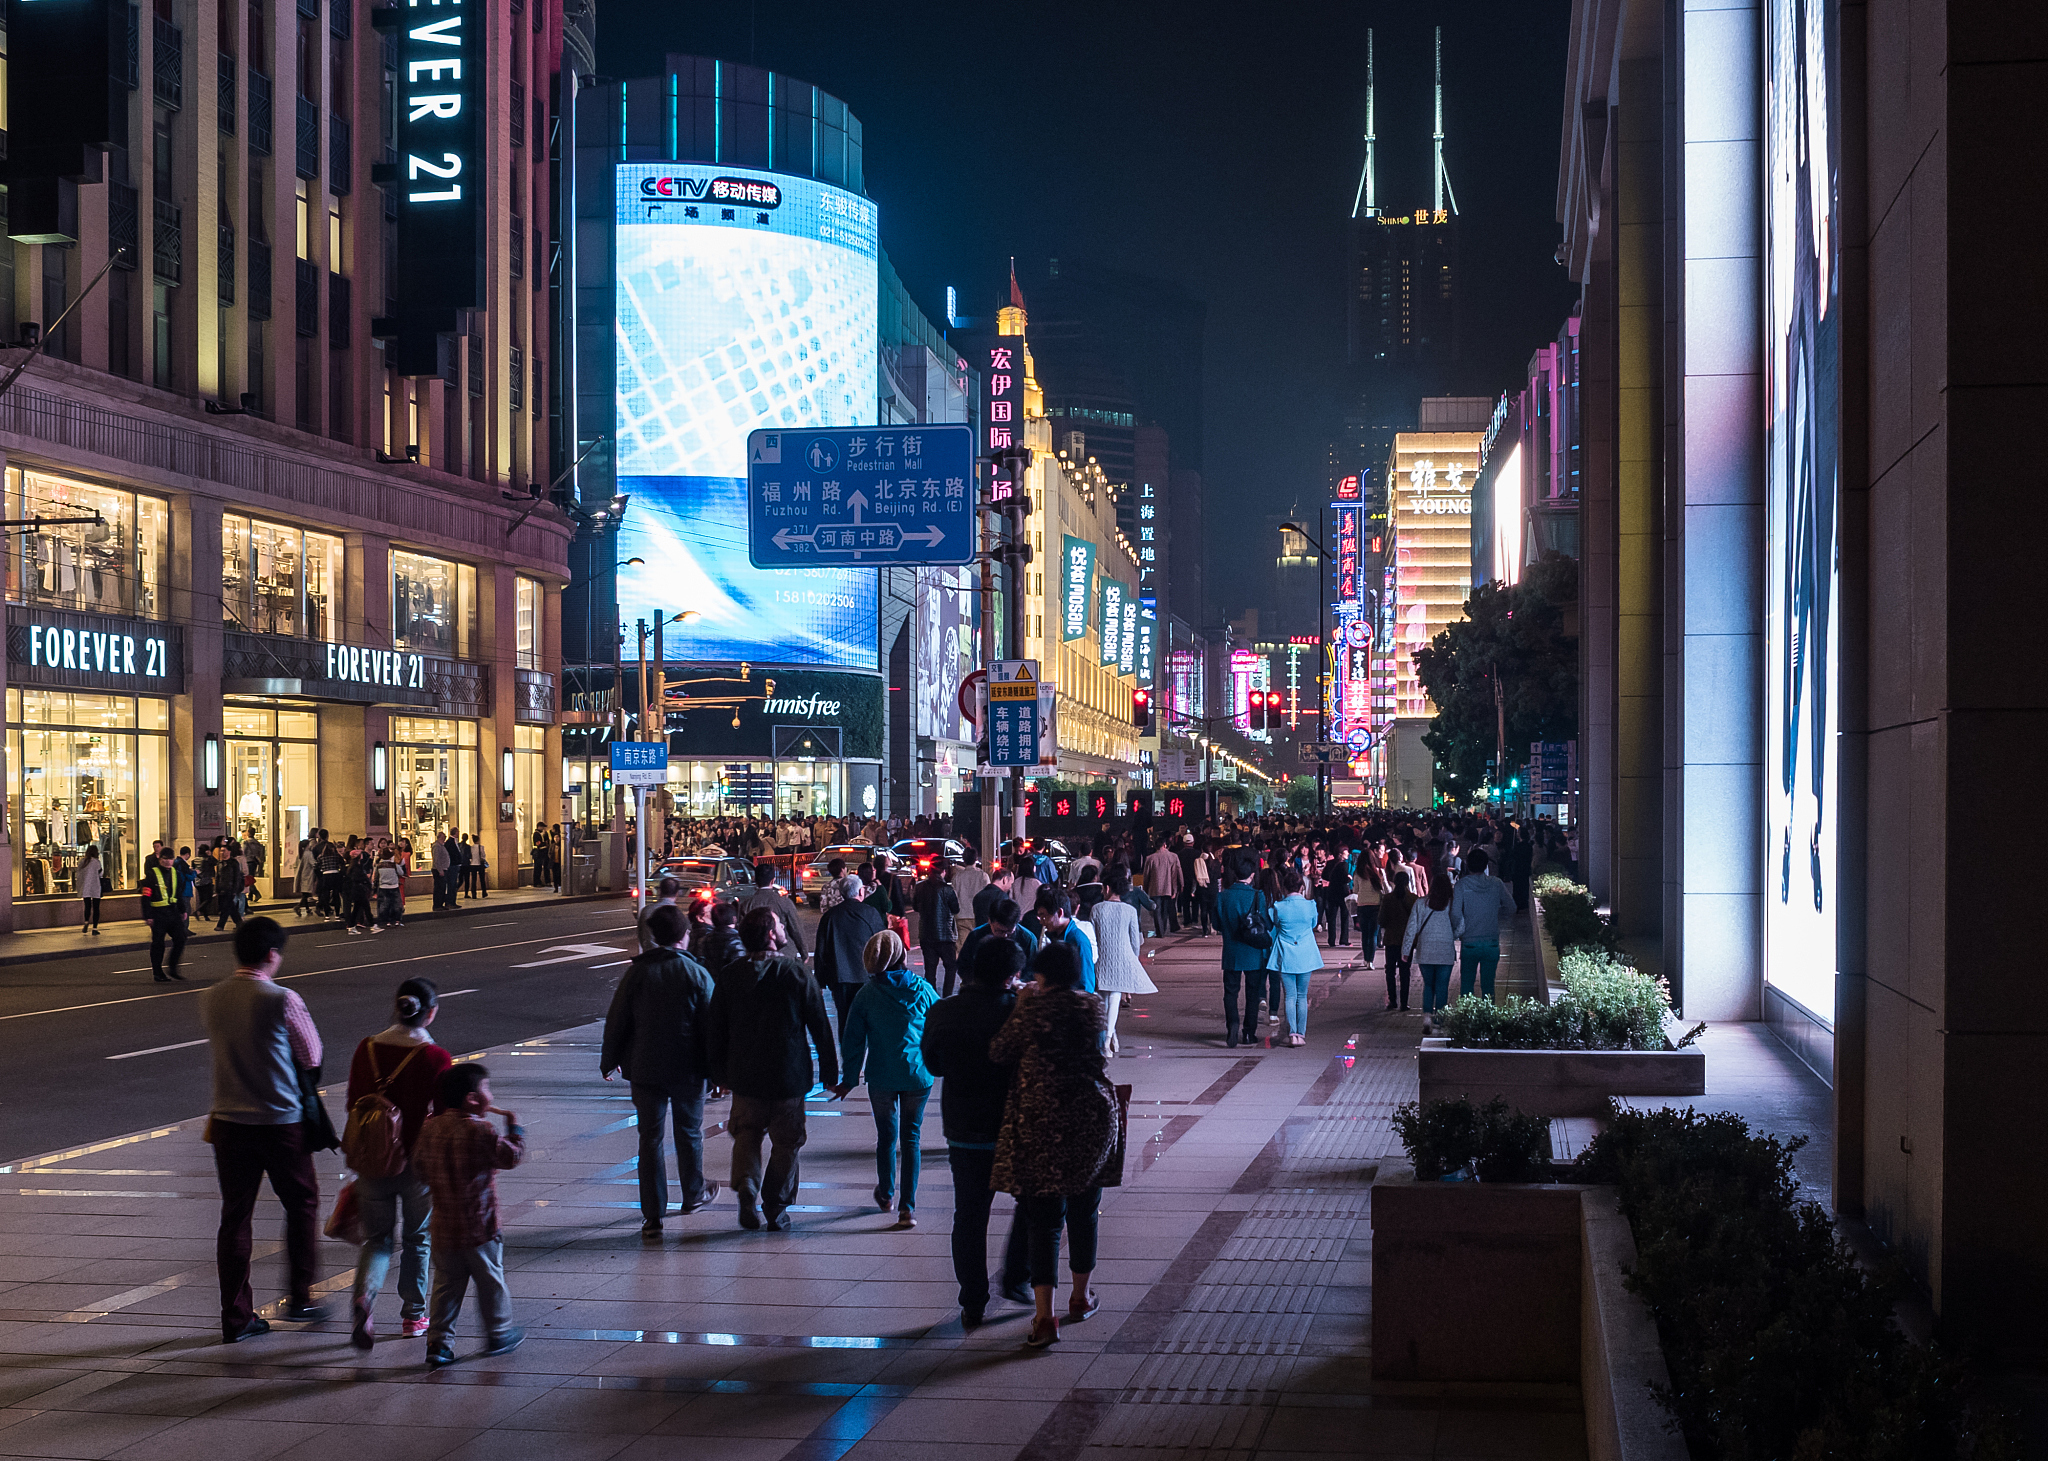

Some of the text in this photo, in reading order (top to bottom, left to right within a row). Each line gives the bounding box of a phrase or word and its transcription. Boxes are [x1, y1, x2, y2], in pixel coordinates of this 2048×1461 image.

[409, 0, 462, 203] VER 21
[640, 177, 708, 197] CCTV
[712, 181, 778, 204] 移动传媒
[648, 205, 770, 226] 广场频道
[1414, 209, 1448, 225] 世茂
[989, 347, 1013, 502] 宏伊国际场
[766, 434, 779, 449] 西
[848, 436, 923, 457] 步行街
[846, 458, 923, 472] Pedestrian Mall
[761, 480, 842, 502] 福州路
[874, 476, 965, 500] 北京东路
[765, 503, 841, 516] Fuzhou Rd.
[875, 500, 963, 517] Beijing Rd. (E)
[1410, 499, 1472, 515] YOUNG
[793, 524, 809, 534] 371
[821, 529, 895, 546] 河南中路
[1140, 483, 1156, 591] 上海置地广
[793, 543, 810, 553] 382
[30, 624, 166, 678] FOREVER 21
[327, 643, 425, 689] FOREVER 21
[763, 691, 841, 720] innisfree
[996, 706, 1010, 761] 车辆绕行
[1018, 706, 1032, 761] 道路拥堵
[624, 746, 656, 766] 南京东路
[616, 772, 621, 782] E
[61, 855, 79, 869] FORE
